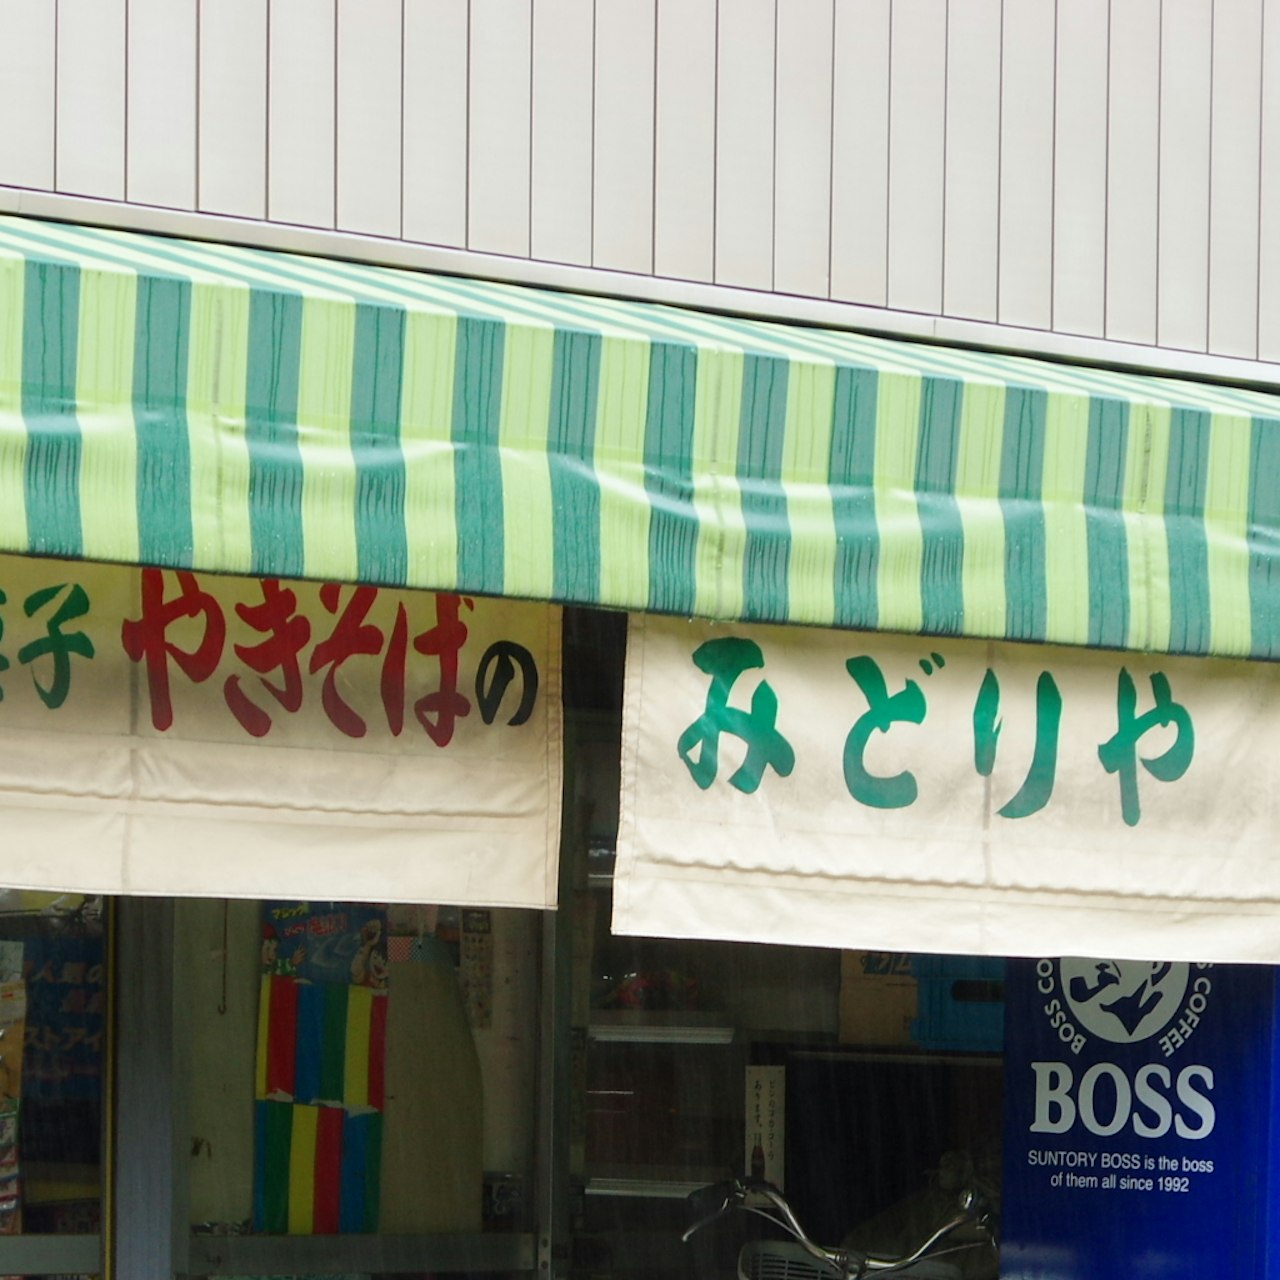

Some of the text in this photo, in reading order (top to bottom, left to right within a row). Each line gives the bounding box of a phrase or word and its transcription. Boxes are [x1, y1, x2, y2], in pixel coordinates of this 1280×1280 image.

[121, 566, 539, 747] やきそばの
[677, 635, 1196, 826] みどりや
[1044, 999, 1087, 1054] BOSS
[1158, 977, 1212, 1057] COFFEE
[1029, 1061, 1216, 1140] BOSS
[1028, 1150, 1214, 1173] SUNTORY BOSS is the boss
[1050, 1173, 1189, 1192] of them all since 1992
